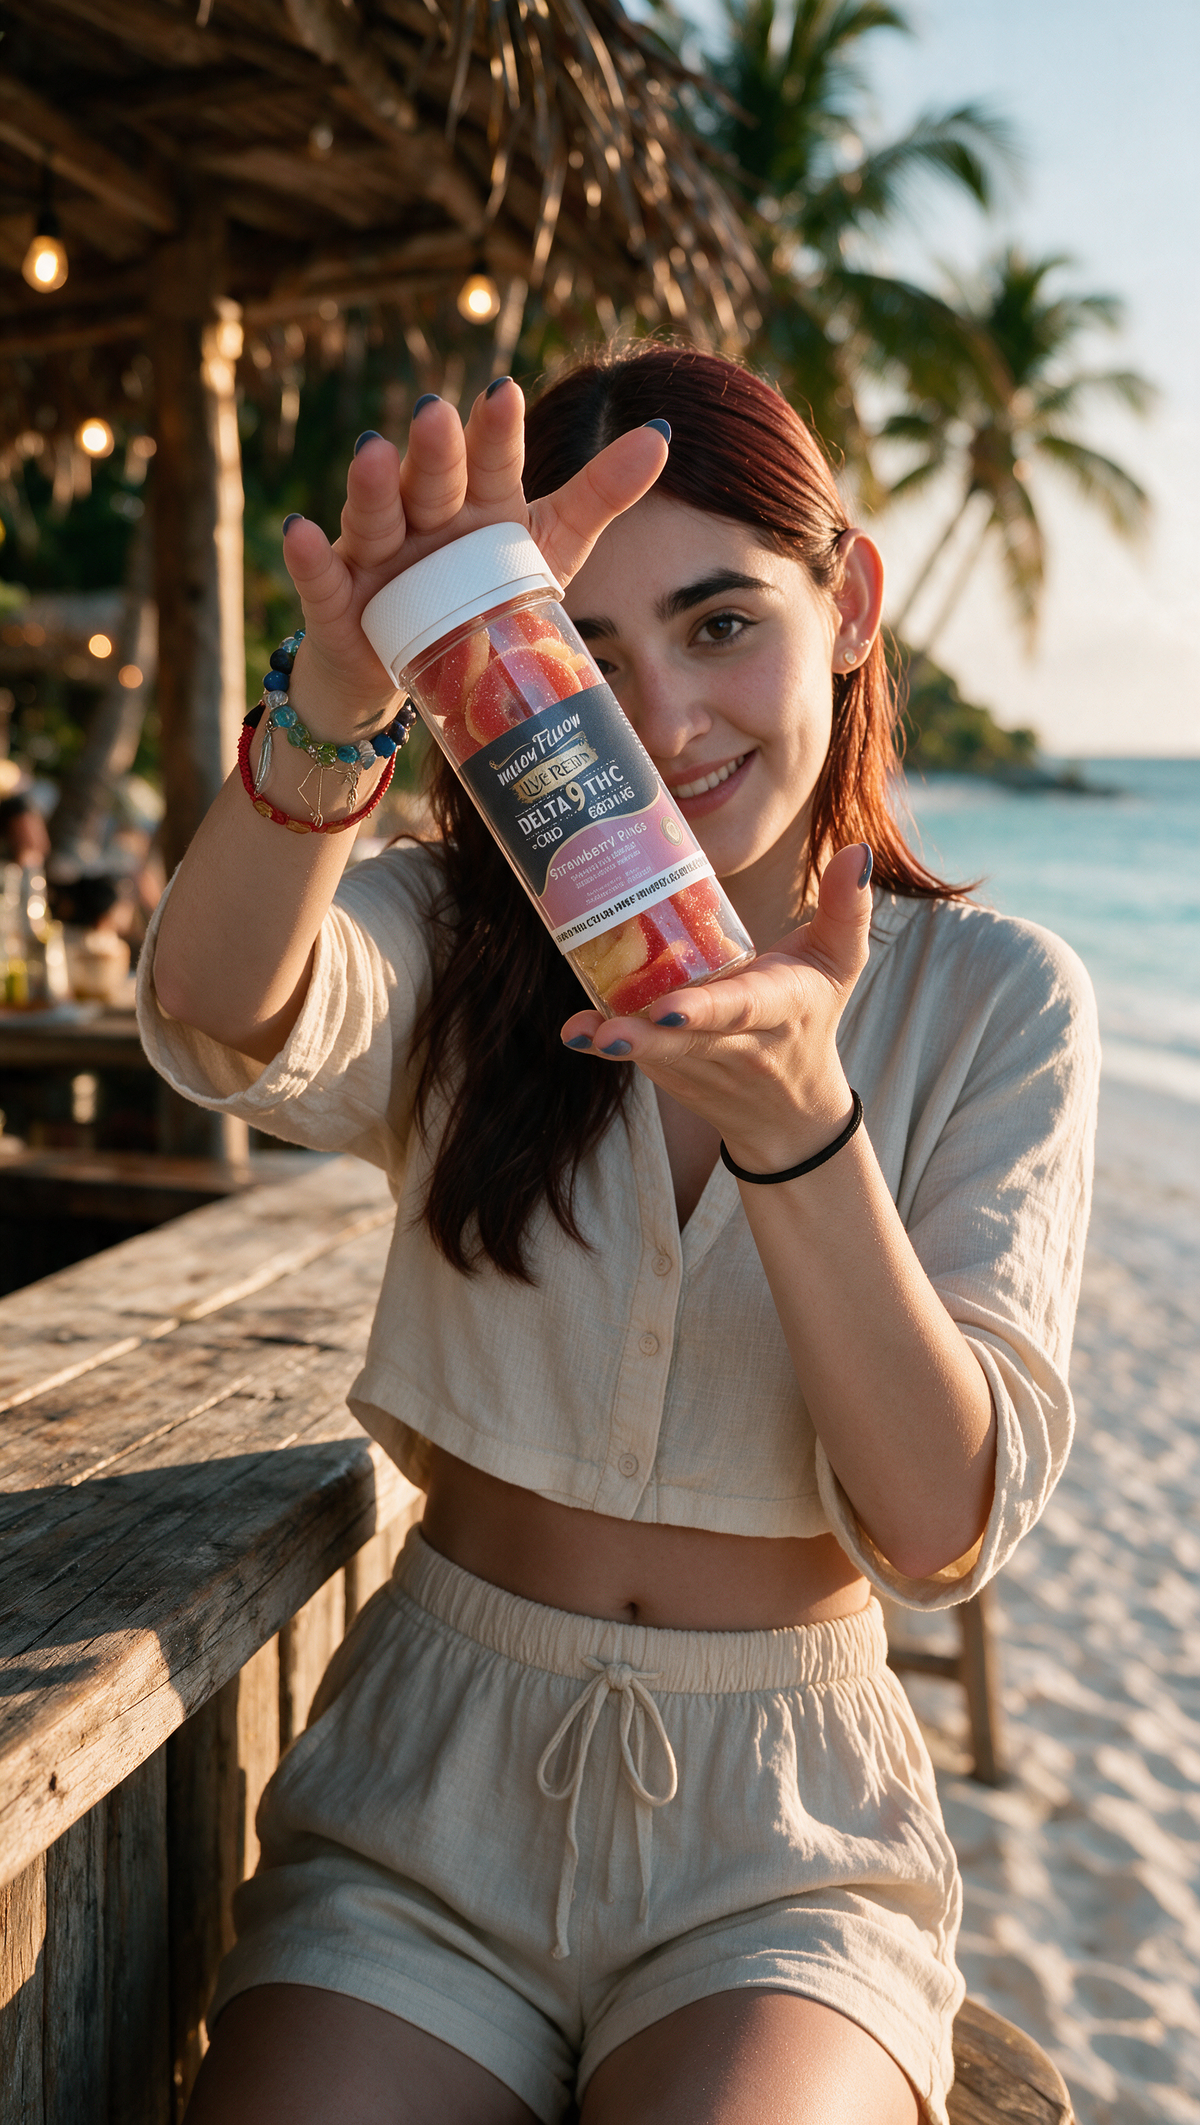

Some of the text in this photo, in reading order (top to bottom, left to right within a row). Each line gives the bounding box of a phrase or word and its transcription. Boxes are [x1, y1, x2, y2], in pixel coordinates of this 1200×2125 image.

[517, 765, 624, 836] DELTA 9 THC
